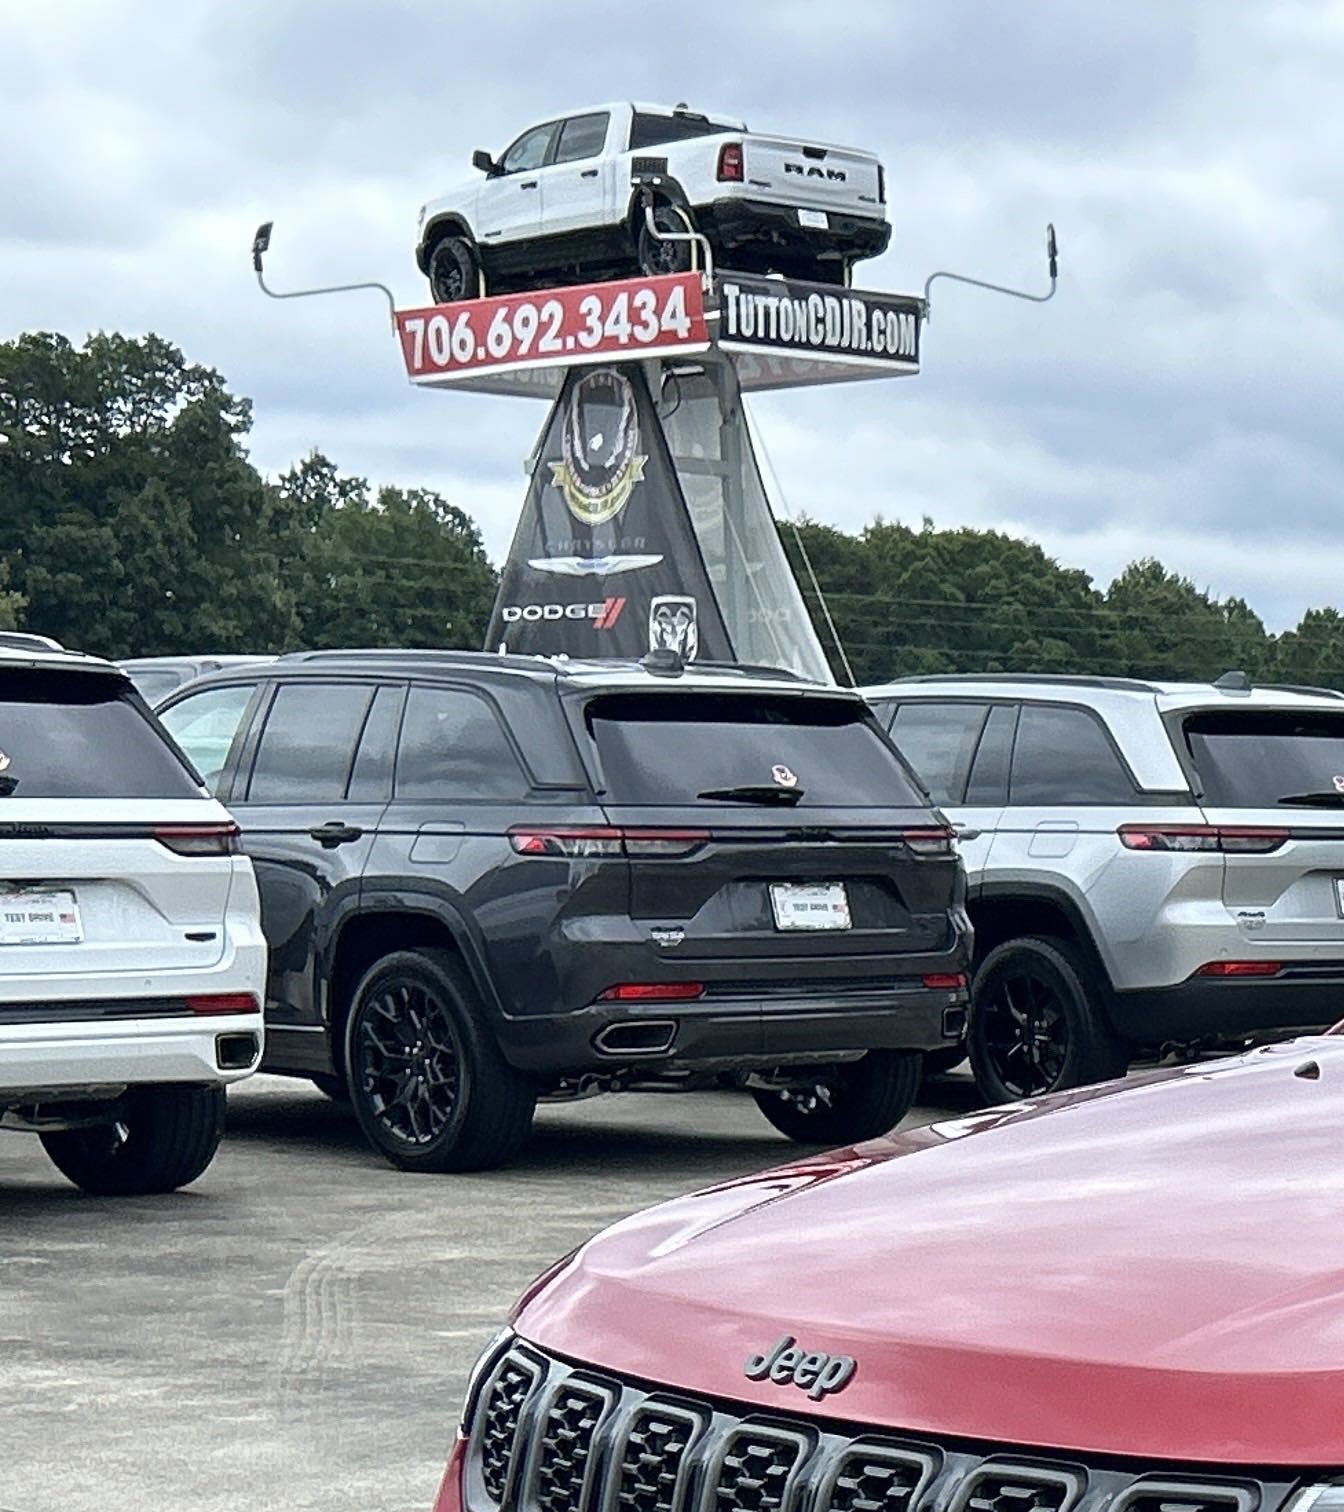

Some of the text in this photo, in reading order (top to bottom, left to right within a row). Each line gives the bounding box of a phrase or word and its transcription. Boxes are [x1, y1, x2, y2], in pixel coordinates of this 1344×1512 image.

[784, 163, 846, 182] RAM
[404, 285, 692, 369] 706.692.3434
[502, 603, 607, 622] DODGE
[744, 1334, 857, 1402] Jeep
